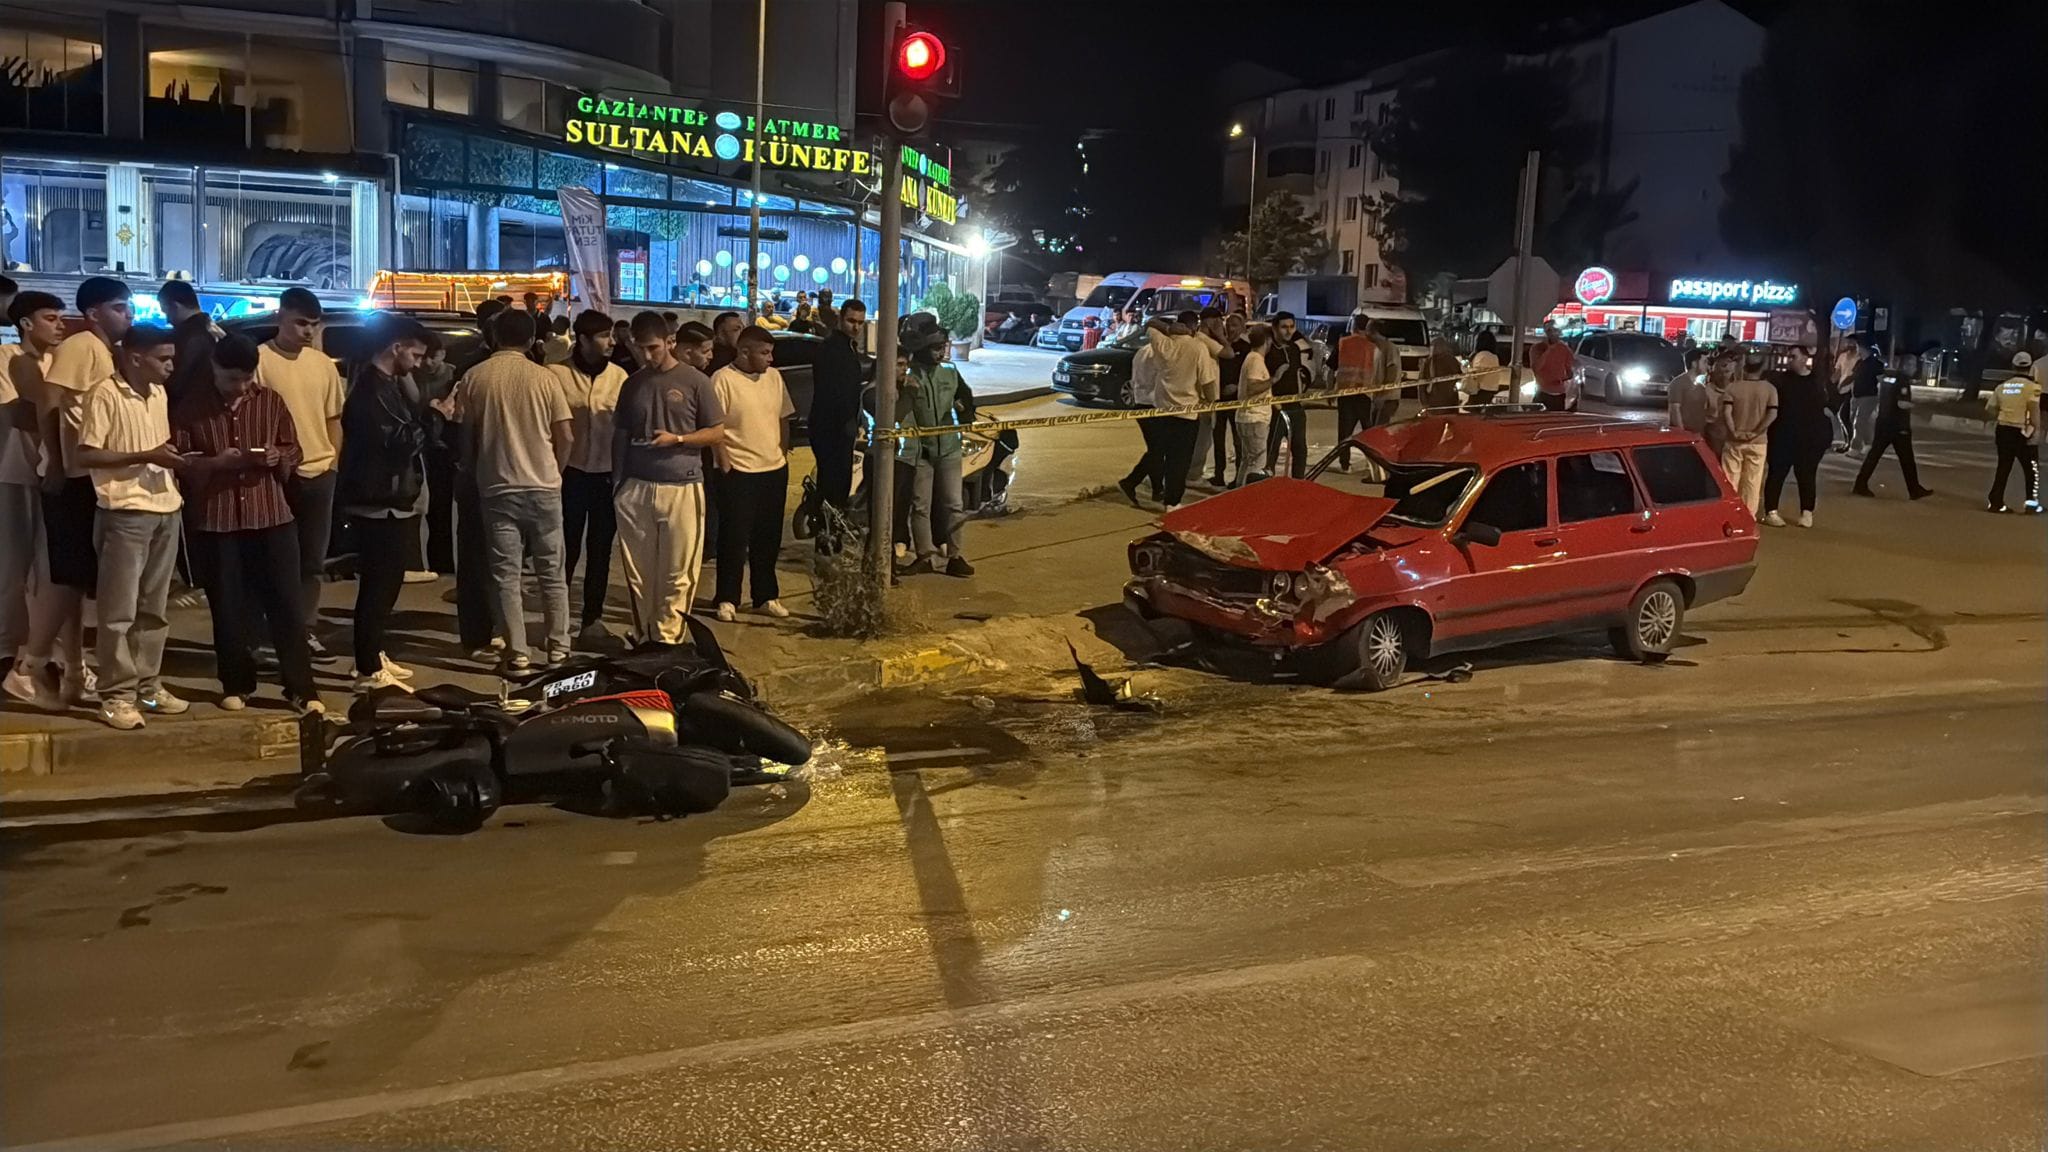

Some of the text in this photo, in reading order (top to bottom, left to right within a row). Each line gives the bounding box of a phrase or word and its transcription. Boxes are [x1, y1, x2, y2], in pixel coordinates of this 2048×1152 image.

[577, 97, 708, 126] GAZİANTEP
[566, 119, 870, 174] SULTANA KÜNEFE
[1671, 279, 1795, 304] pasaport pizza
